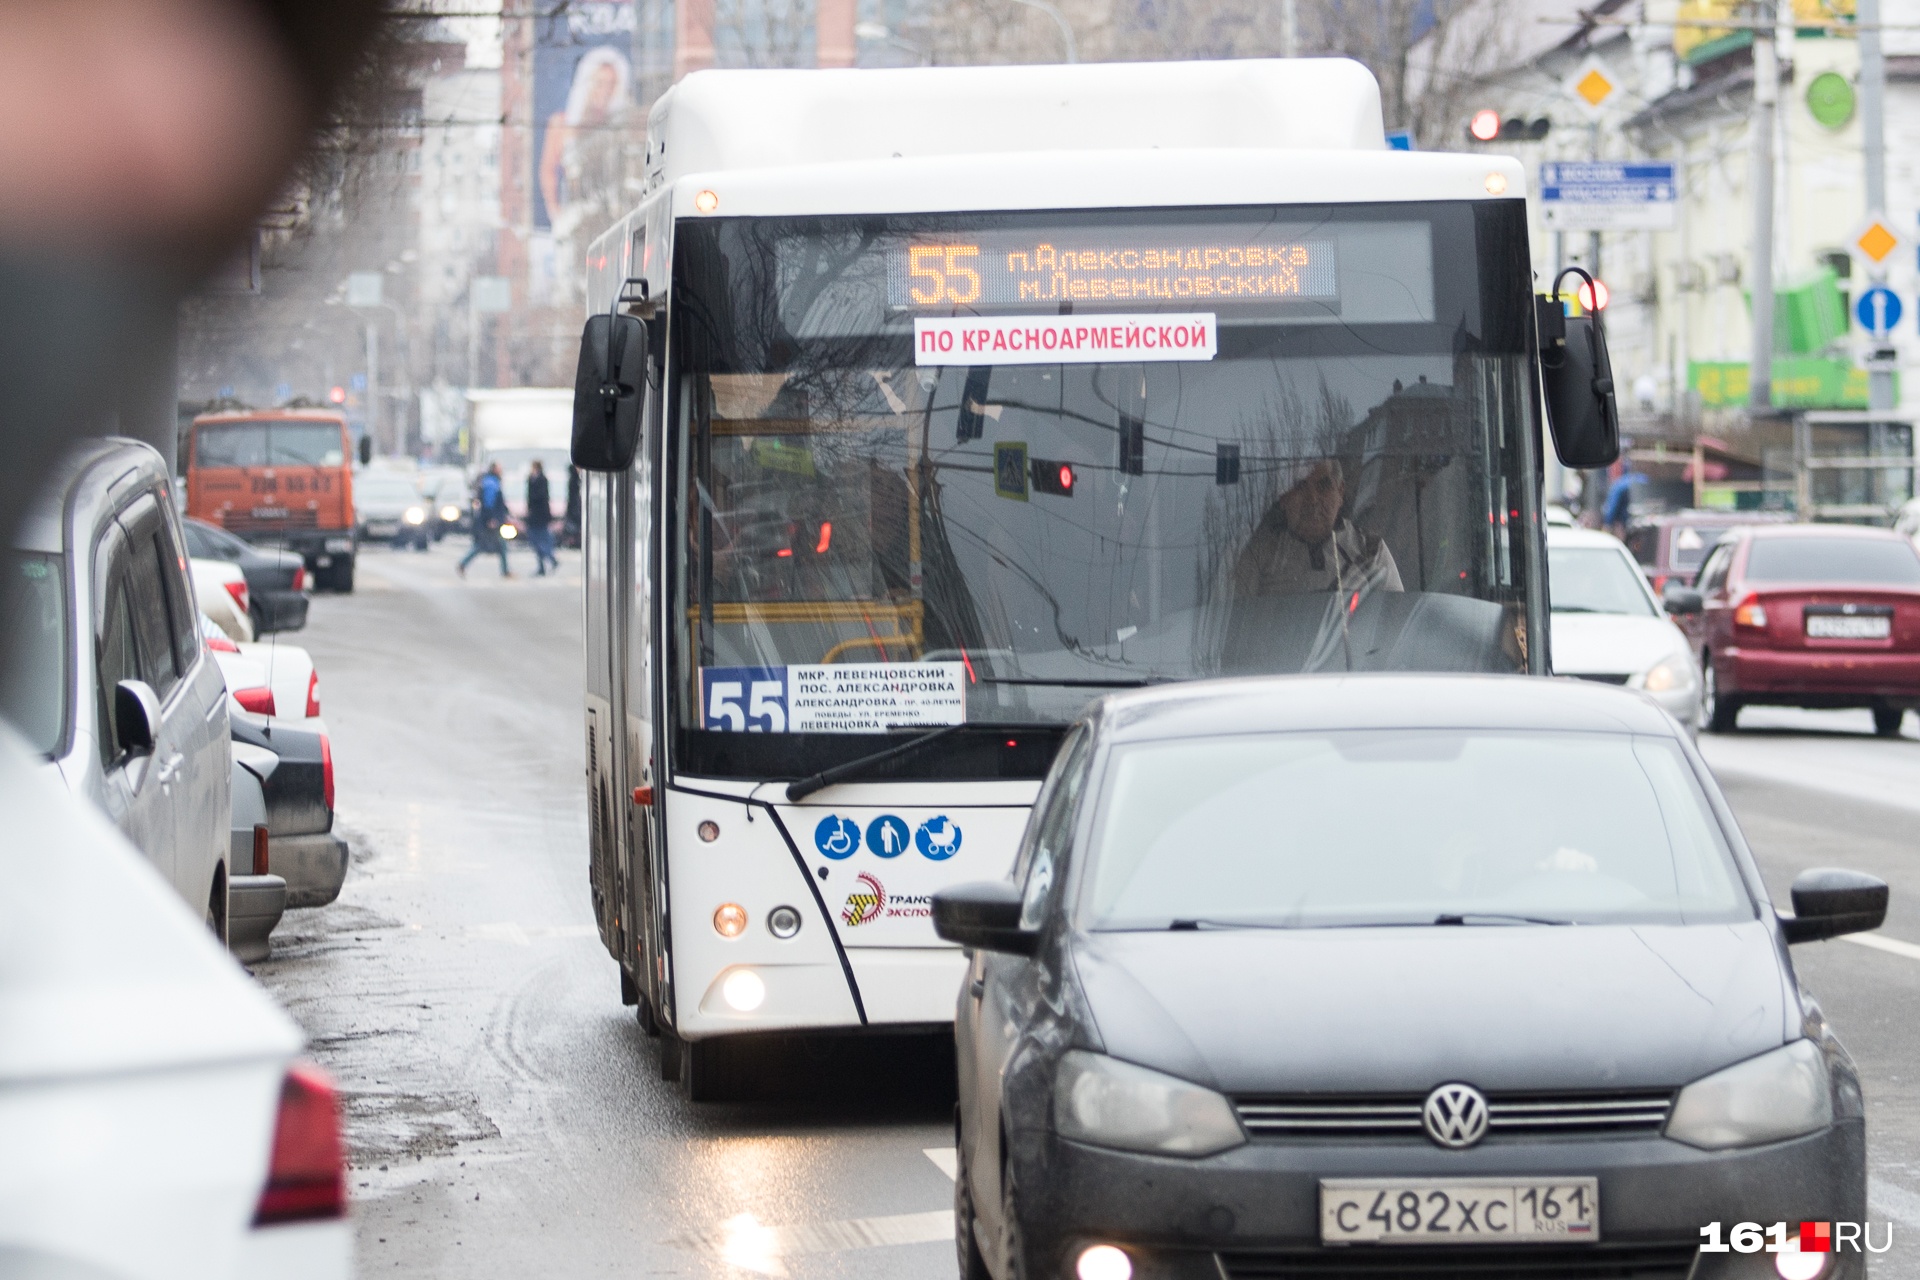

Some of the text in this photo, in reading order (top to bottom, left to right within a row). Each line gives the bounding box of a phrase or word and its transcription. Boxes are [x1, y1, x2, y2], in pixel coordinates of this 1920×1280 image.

[910, 246, 981, 303] 55
[920, 320, 1207, 352] ПО КРАСНОАРМЕЙСКОЙ
[797, 668, 945, 681] МКР. ЛЕВЕНЦОВСКИЙ
[800, 682, 955, 694] ПОС. АЛЕКСАНДРОВКА
[708, 681, 786, 732] 55
[795, 698, 897, 708] АЛЕКСАНДРОВКА
[874, 710, 920, 718] ЕРЕМЕНКО
[800, 720, 880, 731] ЛЕВЕНЦОВКА
[886, 908, 934, 917] ЭКСПО
[1534, 1220, 1566, 1232] RUS
